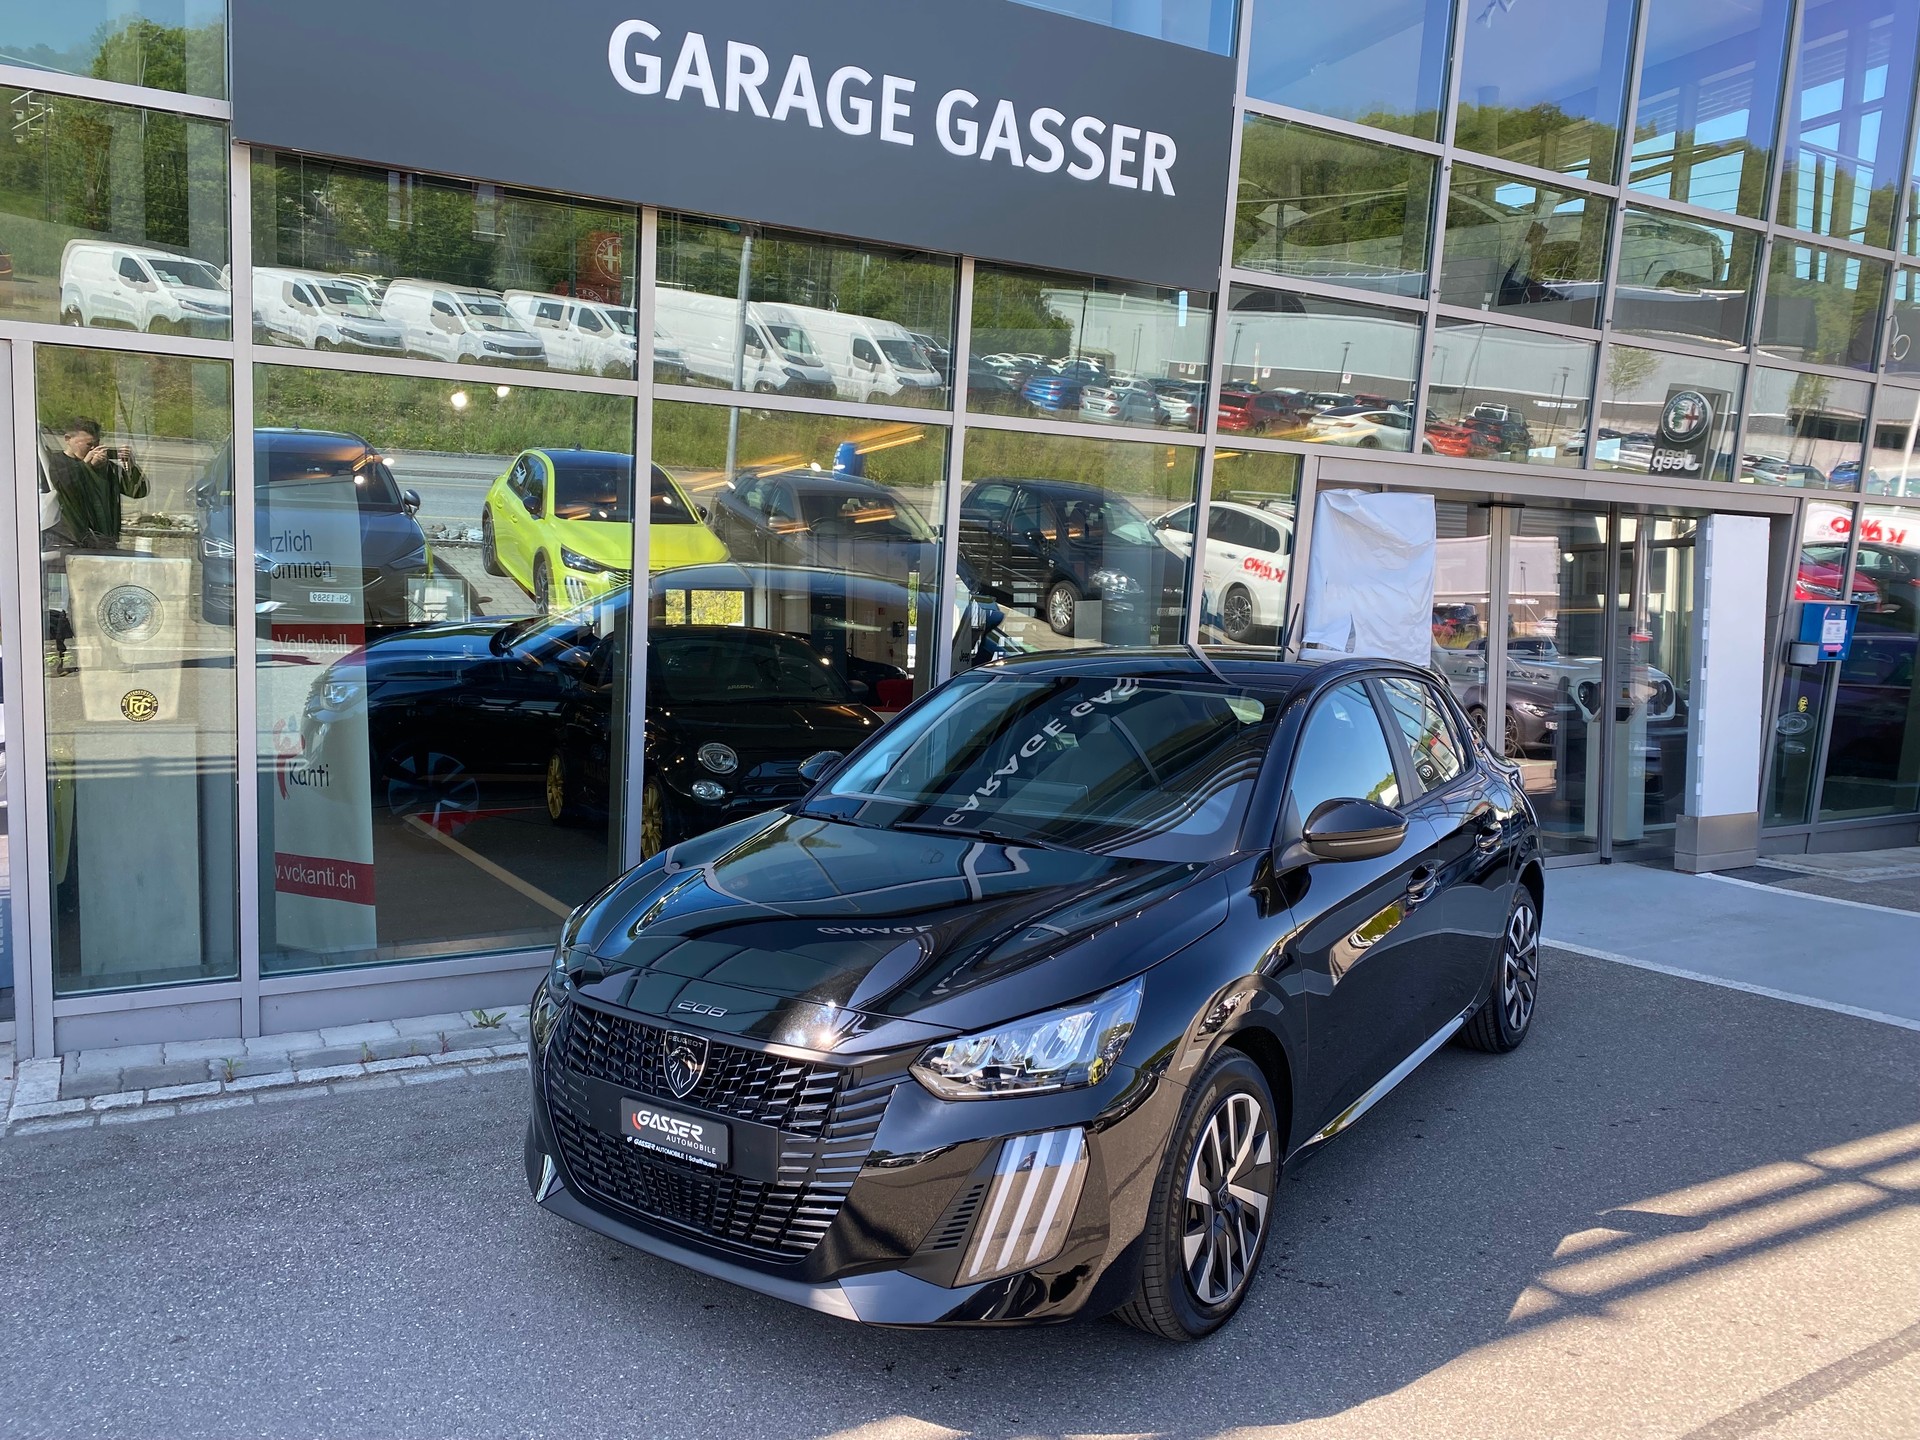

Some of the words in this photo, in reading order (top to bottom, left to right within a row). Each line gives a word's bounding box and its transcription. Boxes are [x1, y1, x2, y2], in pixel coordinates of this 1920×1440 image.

[608, 19, 916, 146] GARAGE
[935, 89, 1177, 197] GASSER
[277, 633, 347, 659] Volleyball
[289, 762, 330, 787] Kanti
[677, 1000, 728, 1017] 208
[667, 1035, 704, 1049] PEUGEOT
[636, 1110, 703, 1143] GASSER
[655, 1145, 685, 1160] AUTOMOBILE
[665, 1134, 717, 1155] AUTOMOBILE
